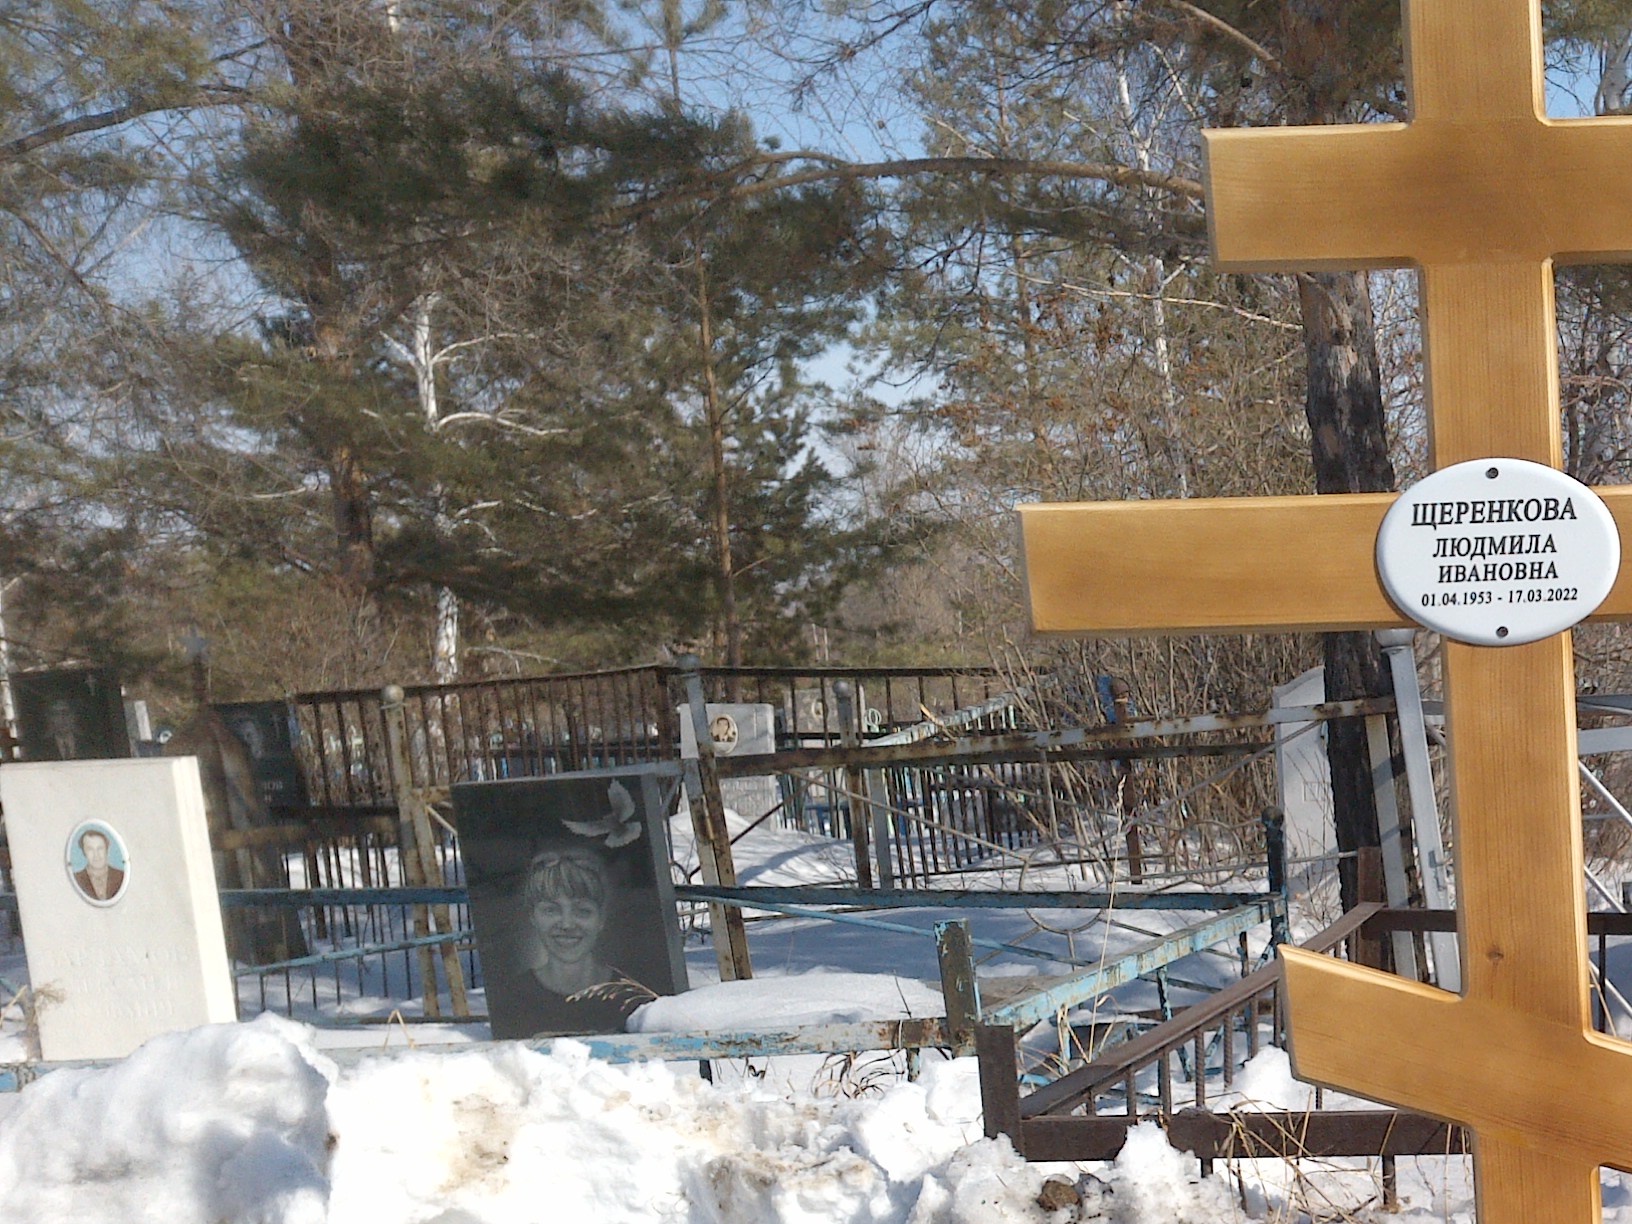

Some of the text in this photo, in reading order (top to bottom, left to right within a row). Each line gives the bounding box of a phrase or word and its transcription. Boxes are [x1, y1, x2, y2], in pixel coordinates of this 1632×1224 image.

[1411, 497, 1578, 531] ЩЕРЕНКОВА
[1432, 533, 1558, 561] ЛЮДМИЛА
[1437, 561, 1559, 584] ИВАНОВНА
[1421, 591, 1493, 607] 01.04.1953
[1508, 587, 1579, 604] 17.03.2022
